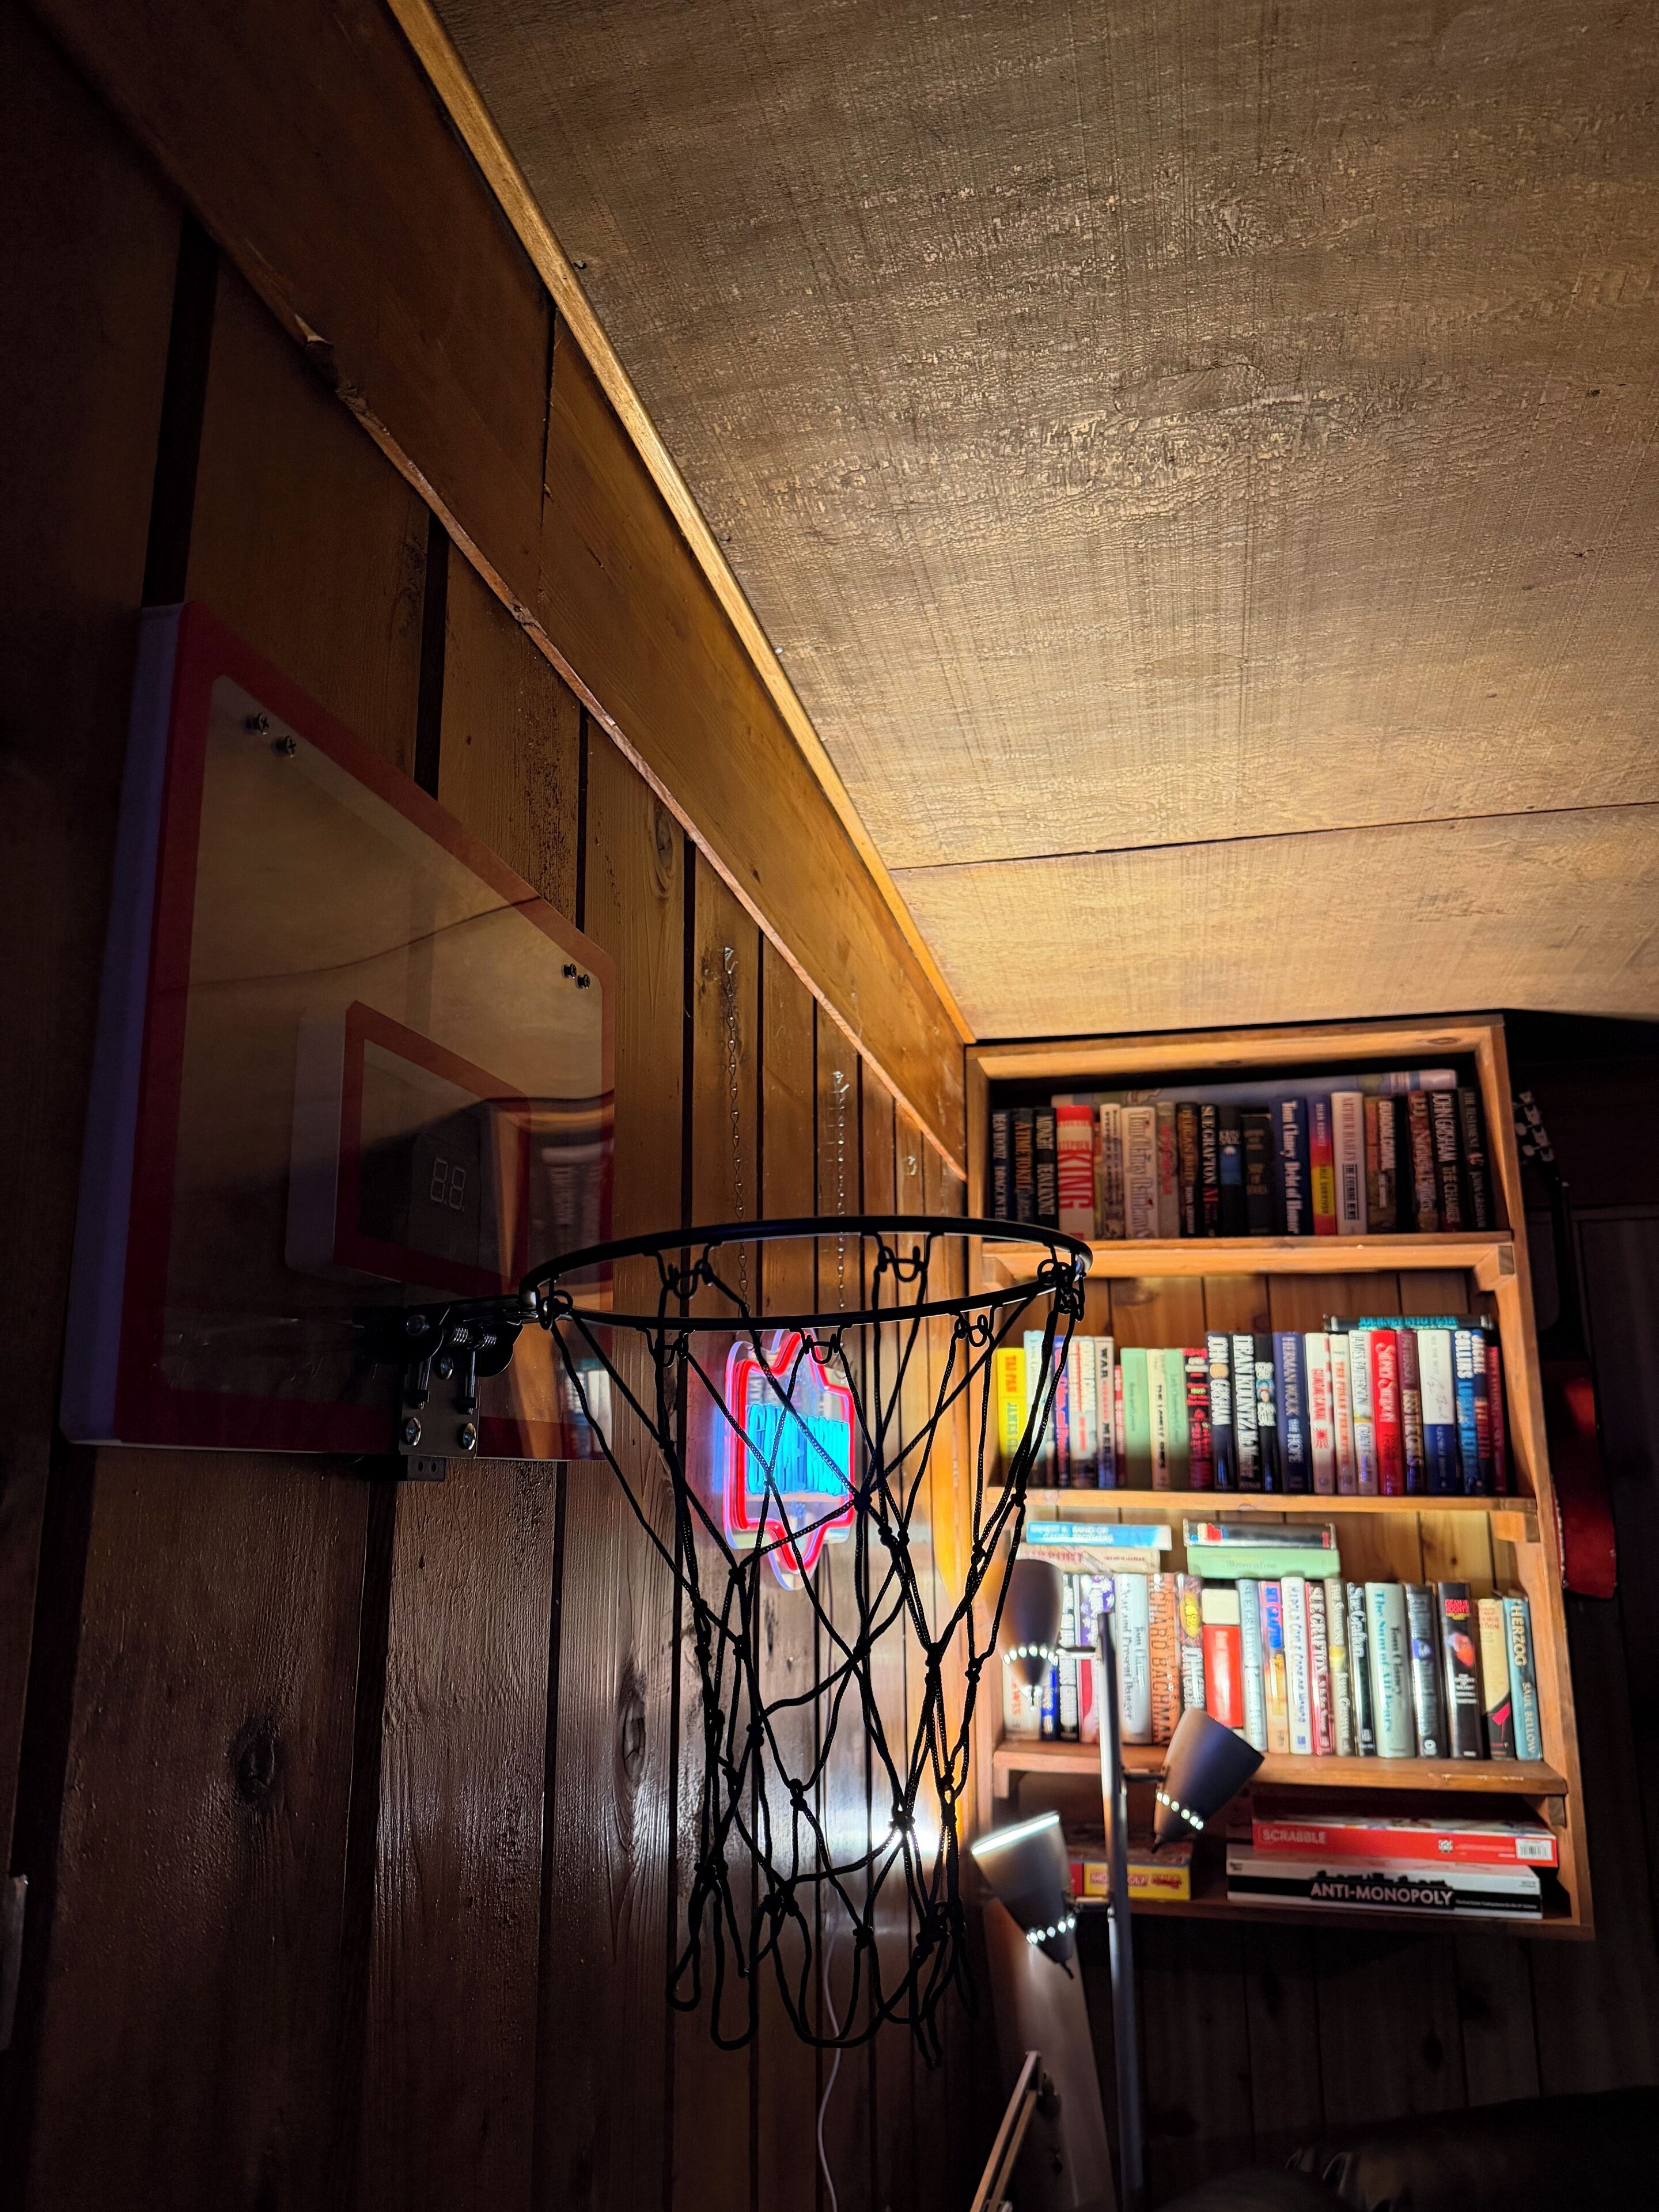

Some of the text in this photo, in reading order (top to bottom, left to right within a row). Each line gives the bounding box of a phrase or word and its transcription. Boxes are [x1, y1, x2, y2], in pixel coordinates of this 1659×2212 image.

[1201, 1105, 1216, 1128] SUE
[1282, 1101, 1298, 1123] Tom
[1432, 1093, 1455, 1118] JOHN
[1015, 1130, 1031, 1154] TIME
[1036, 1116, 1055, 1150] MIDNIGHT
[1279, 1123, 1300, 1159] Clancy
[1434, 1119, 1457, 1162] GRISHAM
[1202, 1129, 1218, 1184] GRAFTON
[1016, 1169, 1032, 1190] KILL
[1058, 1151, 1092, 1209] KING
[1442, 1166, 1456, 1183] THE
[1285, 1188, 1301, 1199] of
[1286, 1200, 1303, 1234] Honor
[1233, 1335, 1255, 1373] DEAN
[1282, 1336, 1299, 1383] HERMAN
[1375, 1342, 1396, 1380] SIDNEY
[1401, 1335, 1414, 1384] PATTERSON
[1455, 1331, 1474, 1378] COLLINS
[1471, 1335, 1486, 1374] JACKIE
[1207, 1336, 1232, 1425] JOHN GRISHAM
[1236, 1374, 1257, 1429] KOONTZ
[1285, 1384, 1300, 1416] WOUK
[1378, 1379, 1397, 1423] SHELDON
[1403, 1389, 1418, 1413] KISS
[1287, 1433, 1303, 1463] HOPE
[1309, 1586, 1324, 1613] SUE
[1374, 1592, 1387, 1618] The
[1122, 1612, 1133, 1633] and
[1134, 1626, 1145, 1646] Tom
[1244, 1609, 1256, 1661] GRAFTON
[1349, 1586, 1368, 1657] Sue Grafton
[1377, 1620, 1388, 1650] Sum
[1122, 1637, 1134, 1678] Present
[1149, 1574, 1171, 1747] RICHARD BACHMAN
[1182, 1646, 1203, 1676] JOHN
[1309, 1613, 1327, 1676] GRAFTON
[1331, 1584, 1350, 1739] THE SUMMONS JOHN GRISHAM
[1380, 1653, 1391, 1666] of
[1389, 1626, 1404, 1696] Tom Clancy
[1382, 1670, 1392, 1690] All
[1510, 1605, 1536, 1755] HERZOG SAUL BELLOW
[1263, 1828, 1325, 1843] SCRABBLE
[1092, 1873, 1145, 1885] MOOLY
[1310, 1882, 1453, 1906] ANTI-MONOPOLY
